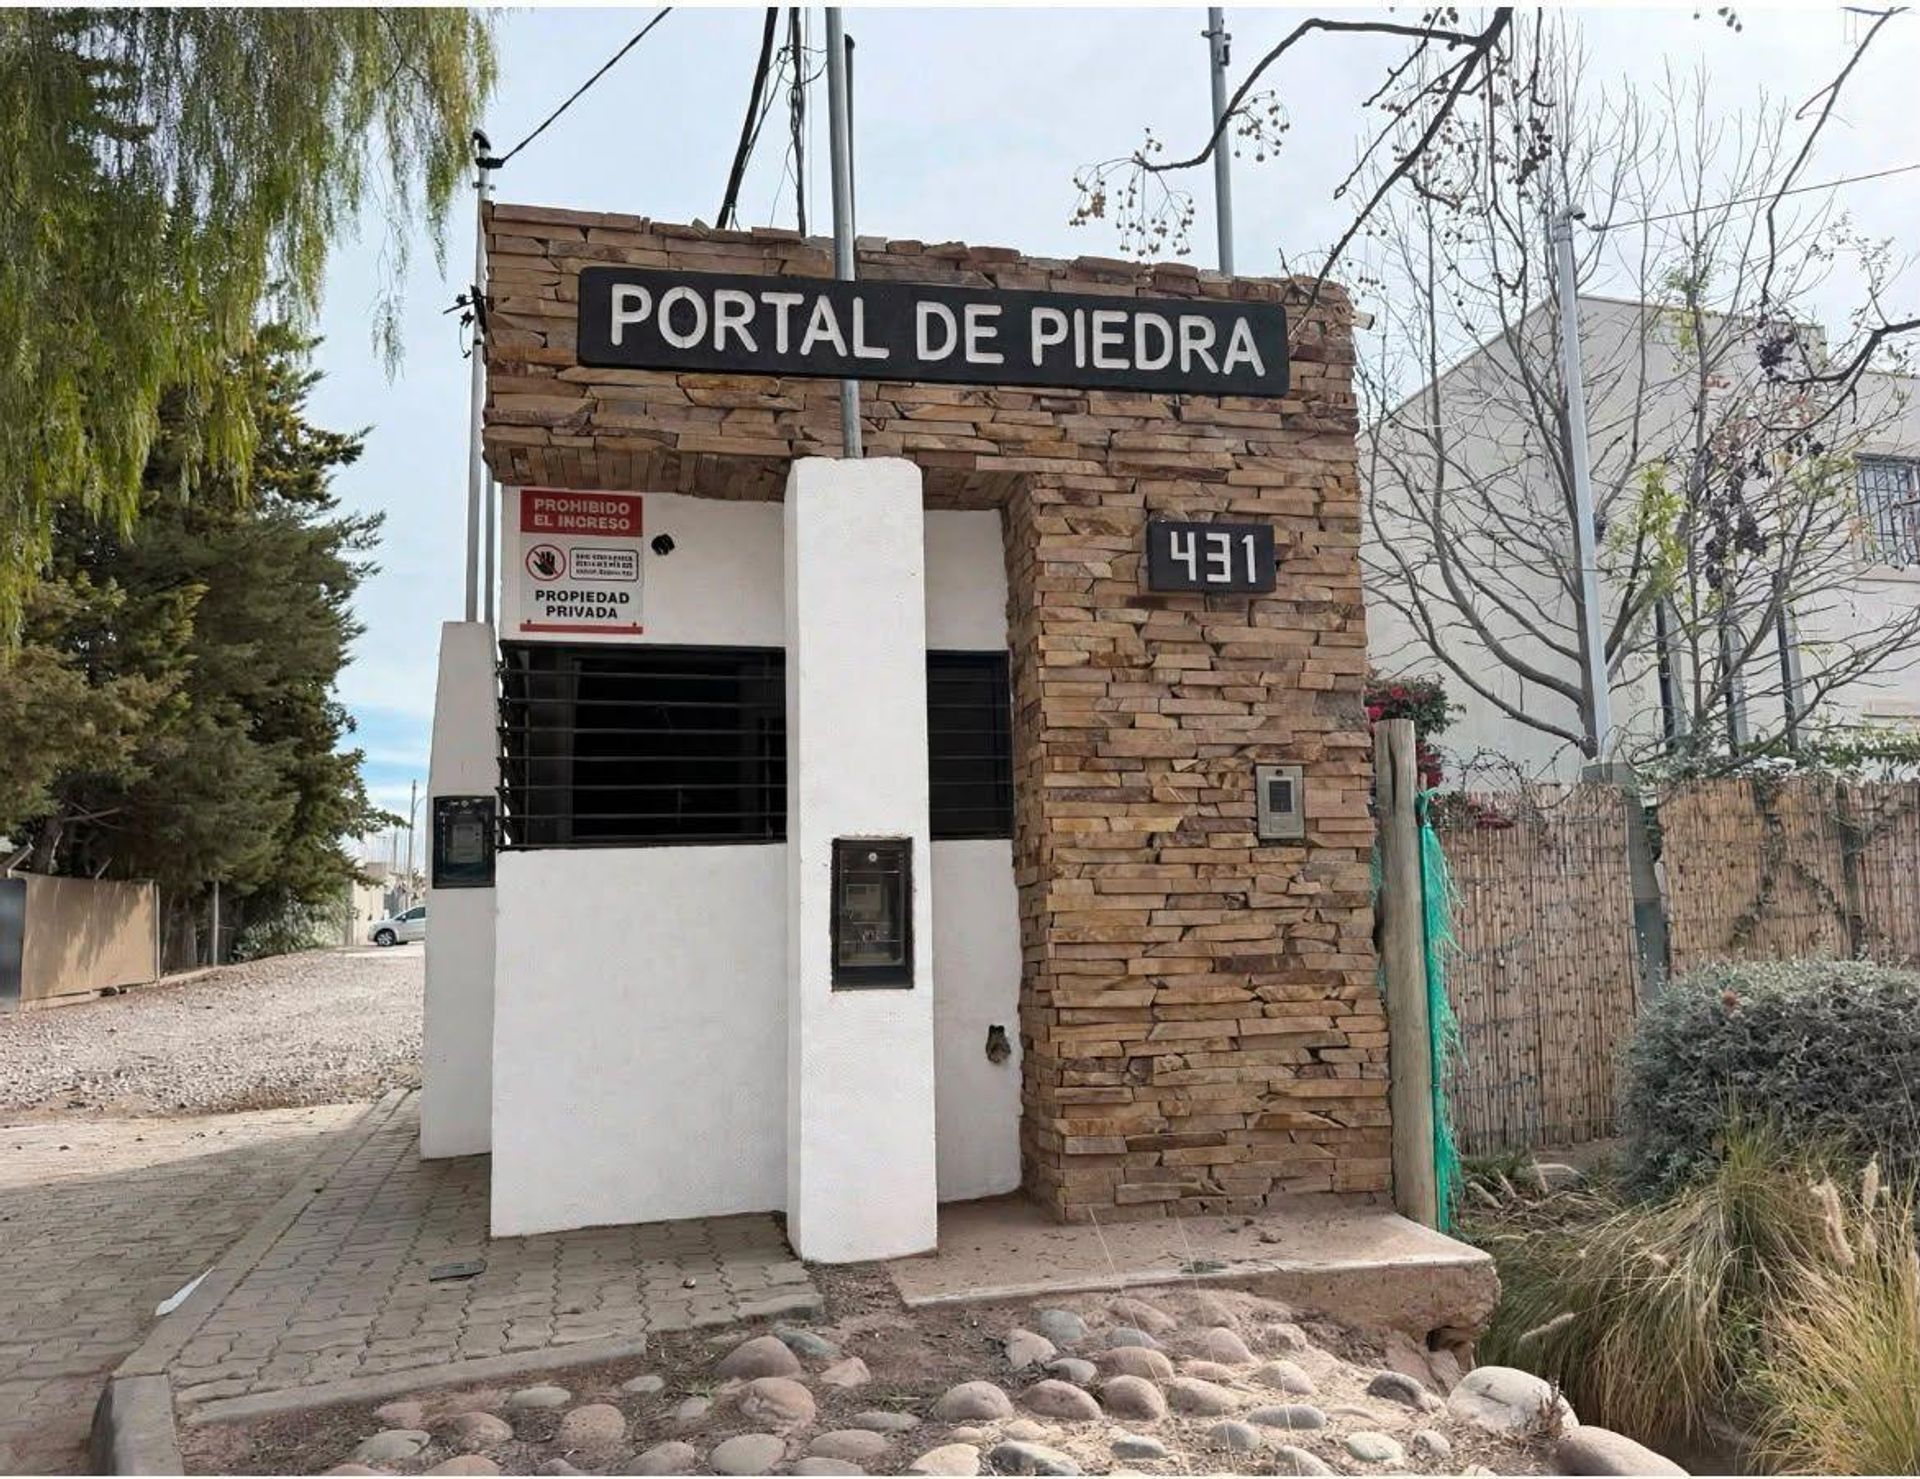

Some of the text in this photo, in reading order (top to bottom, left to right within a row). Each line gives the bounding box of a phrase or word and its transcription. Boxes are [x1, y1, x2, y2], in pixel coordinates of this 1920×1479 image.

[611, 283, 1266, 377] PORTAL DE PIEDRA
[534, 498, 630, 515] PROHIBIDO
[534, 513, 630, 530] EL INGRESO
[1170, 531, 1256, 583] 431
[535, 590, 630, 604] PROPIEDAD
[546, 605, 618, 619] PRIVADA
